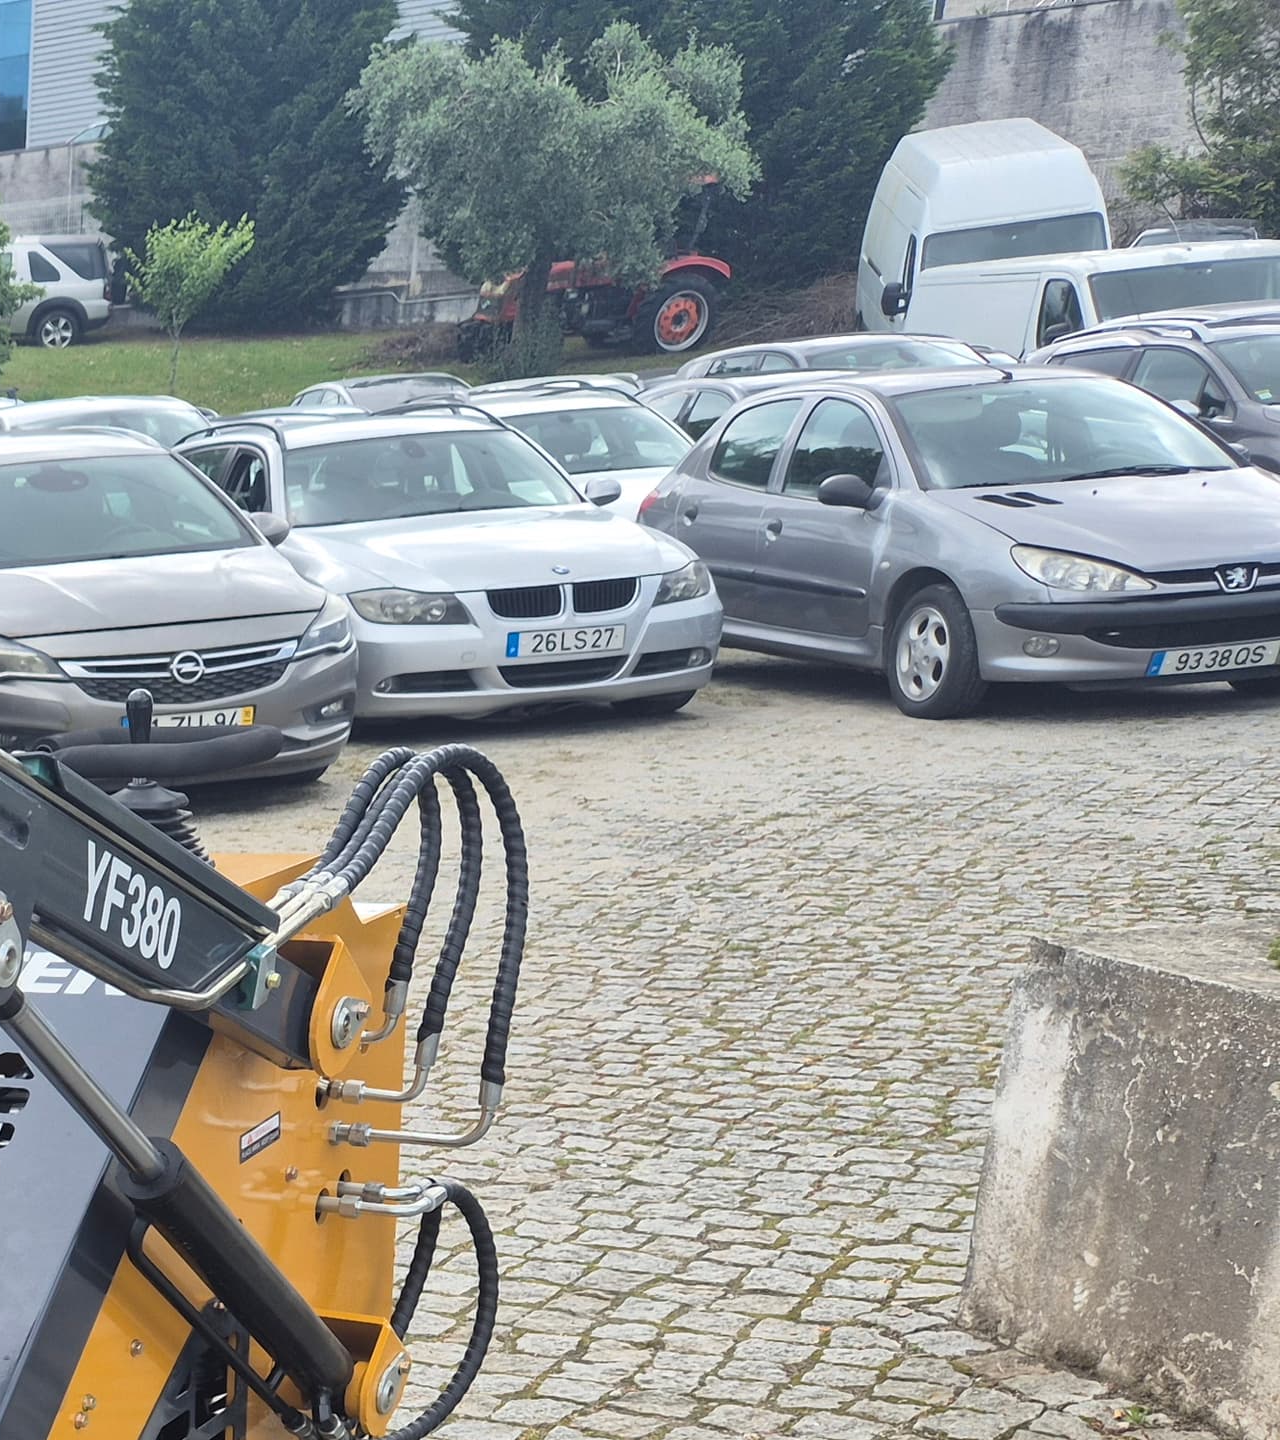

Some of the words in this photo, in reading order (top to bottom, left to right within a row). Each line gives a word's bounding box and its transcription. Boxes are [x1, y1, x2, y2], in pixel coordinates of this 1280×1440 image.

[532, 627, 615, 653] 26LS27
[1175, 645, 1267, 671] 9338QS
[83, 839, 181, 970] YF380
